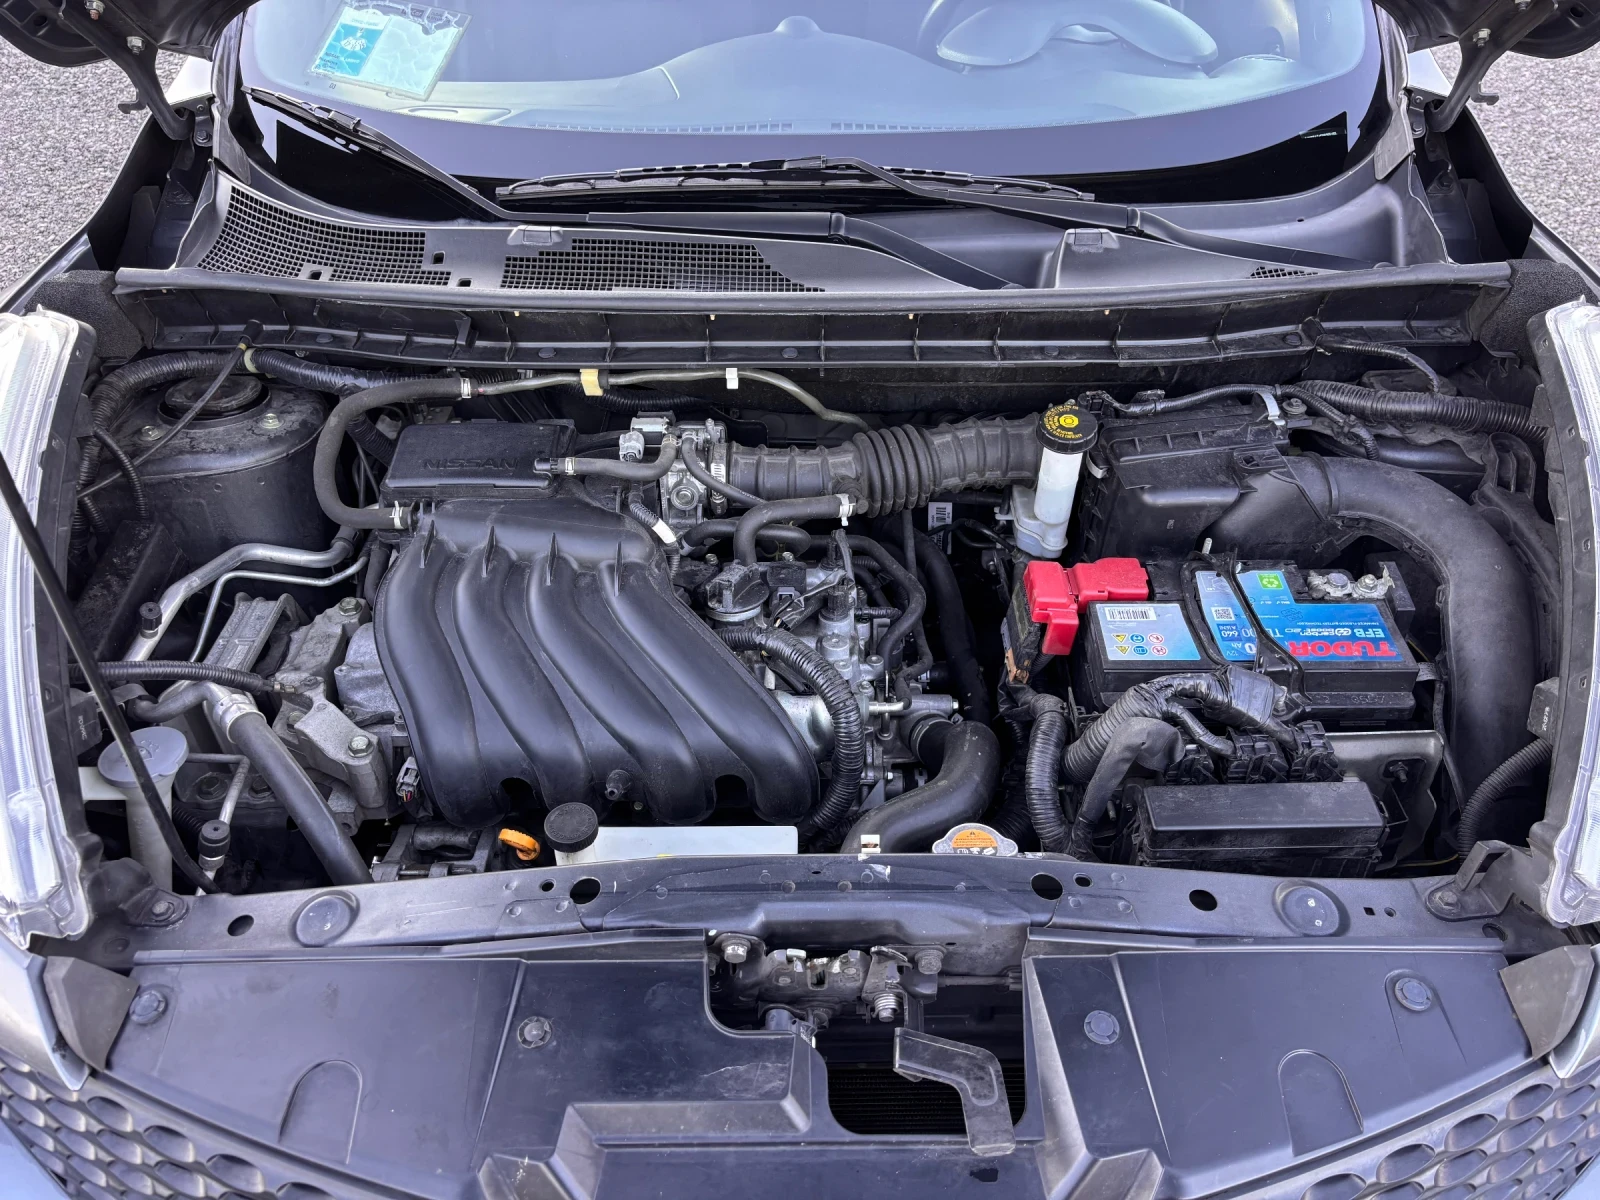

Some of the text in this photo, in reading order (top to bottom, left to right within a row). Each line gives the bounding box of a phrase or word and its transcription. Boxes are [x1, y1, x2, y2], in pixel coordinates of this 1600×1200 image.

[421, 458, 519, 470] NISSAN
[1354, 628, 1385, 638] EFB
[1288, 640, 1397, 657] TUDOR
